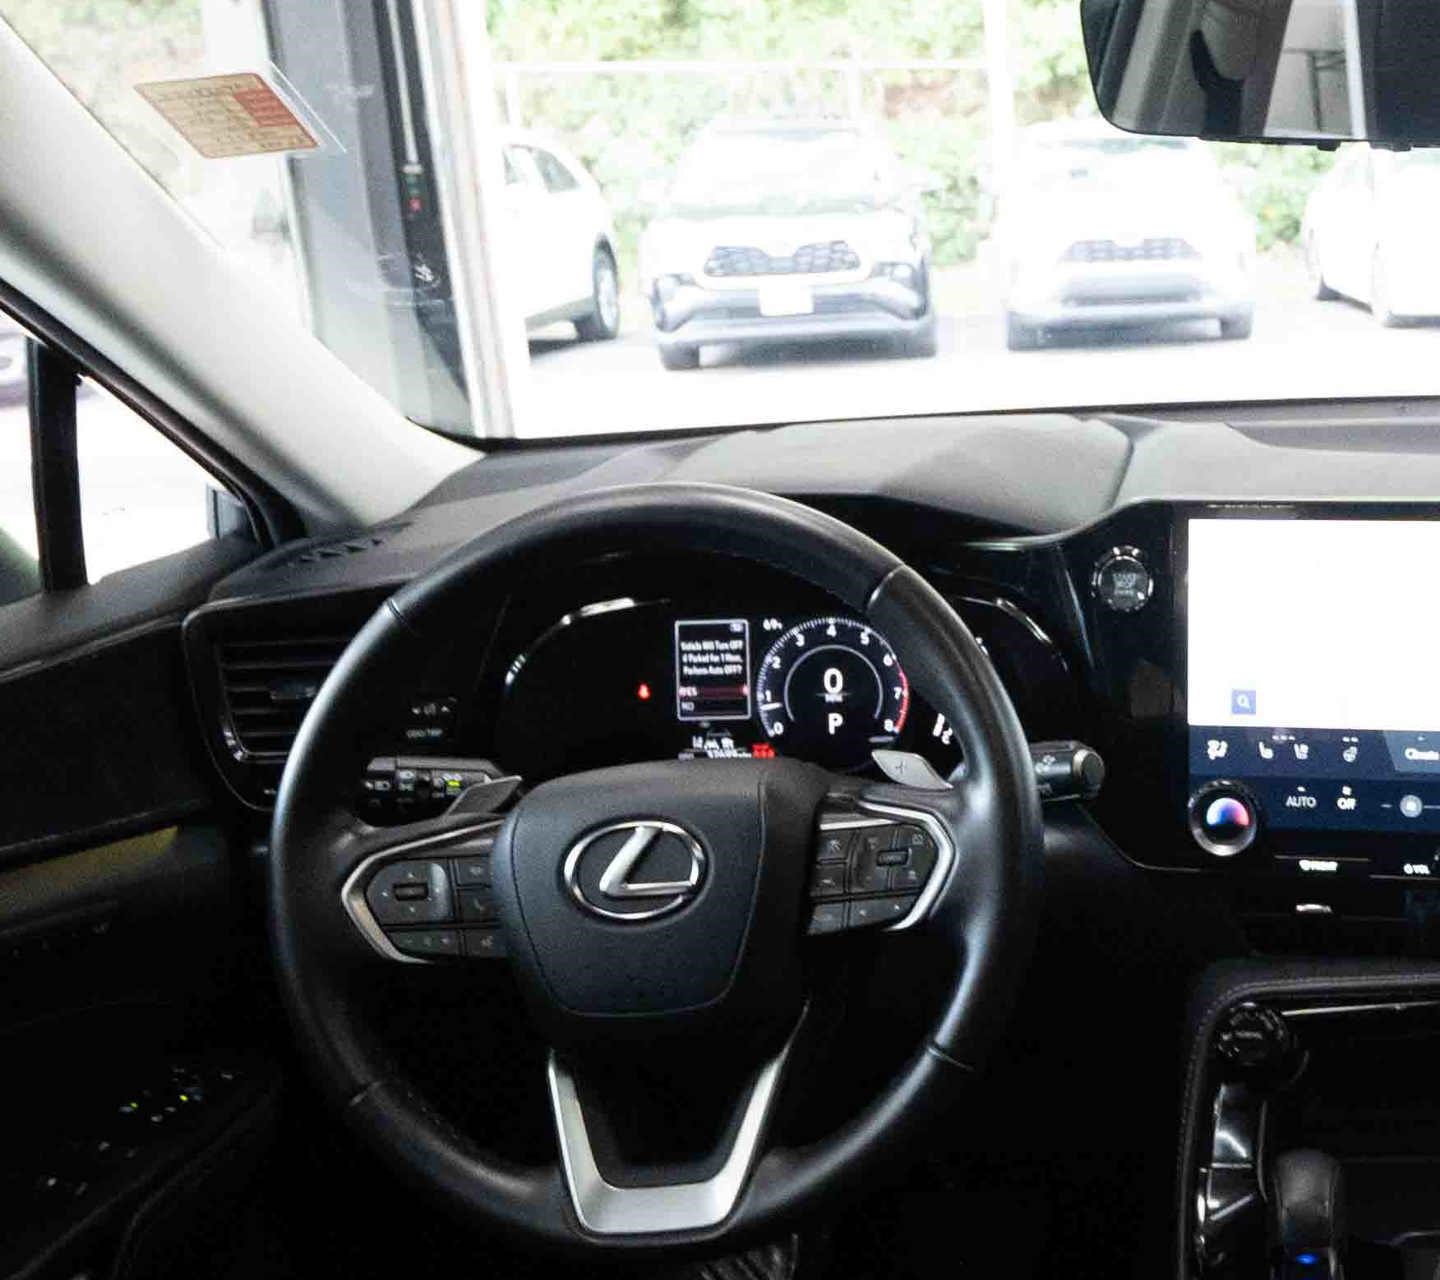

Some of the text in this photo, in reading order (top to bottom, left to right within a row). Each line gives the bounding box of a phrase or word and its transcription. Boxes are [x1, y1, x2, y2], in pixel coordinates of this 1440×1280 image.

[826, 625, 837, 637] 4
[796, 634, 805, 647] 3
[860, 632, 870, 645] 5
[772, 656, 781, 669] 2
[883, 654, 893, 666] 6
[824, 668, 843, 693] 0
[894, 687, 902, 700] 7
[773, 722, 784, 735] 0
[829, 713, 843, 735] P
[1285, 796, 1316, 809] AUTO
